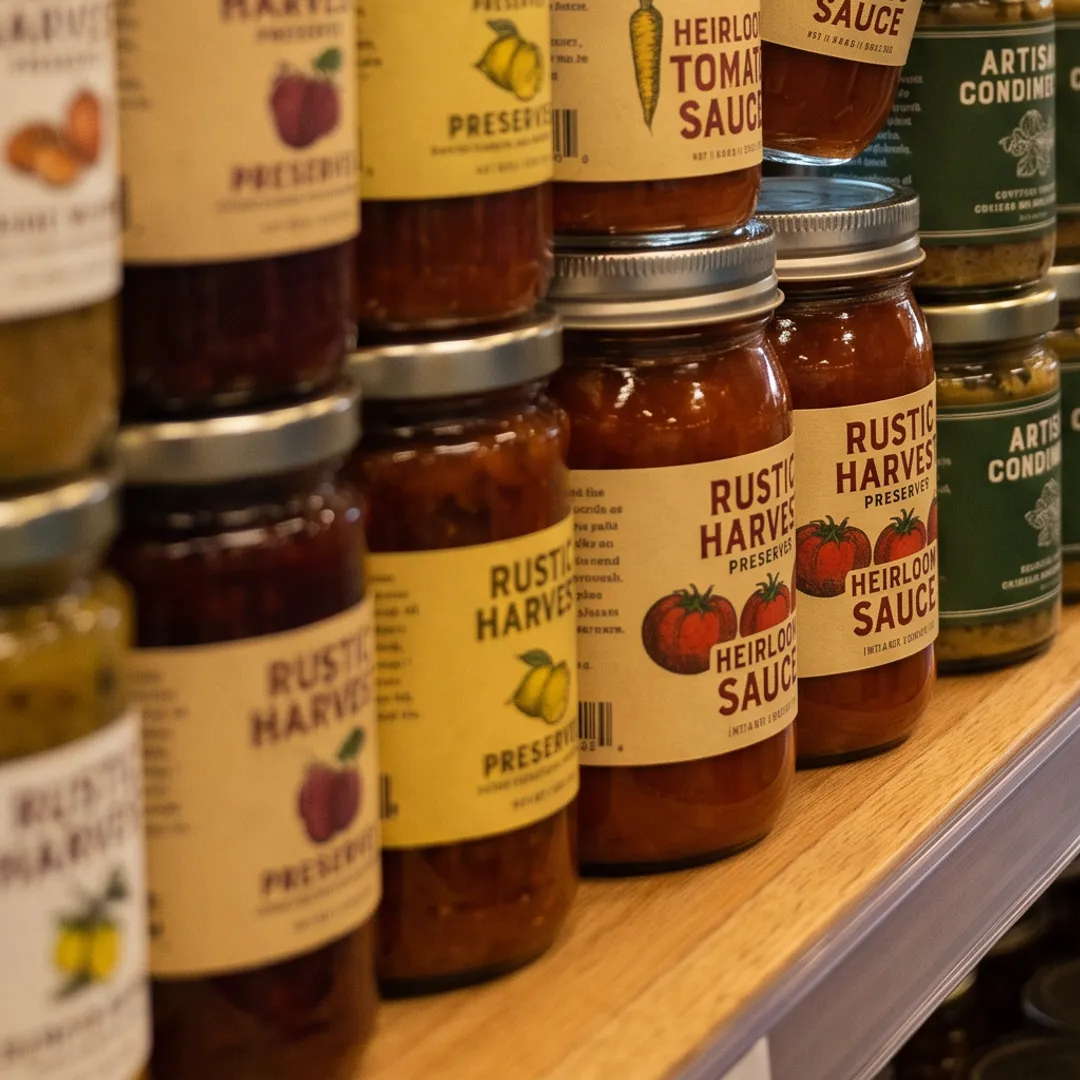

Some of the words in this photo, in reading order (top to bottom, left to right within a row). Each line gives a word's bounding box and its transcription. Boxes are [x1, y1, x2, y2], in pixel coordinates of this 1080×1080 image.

[674, 11, 760, 47] HEIRLOO
[959, 73, 1056, 106] CONDIME
[846, 399, 935, 455] RUSTIC
[1008, 412, 1061, 453] ARTIS
[710, 452, 794, 516] RUSTIC
[864, 477, 930, 509] PRESERVES
[700, 492, 795, 560] HARVES
[475, 576, 572, 642] HARVES
[852, 574, 936, 637] SAUCE
[718, 645, 797, 717] SAUCE
